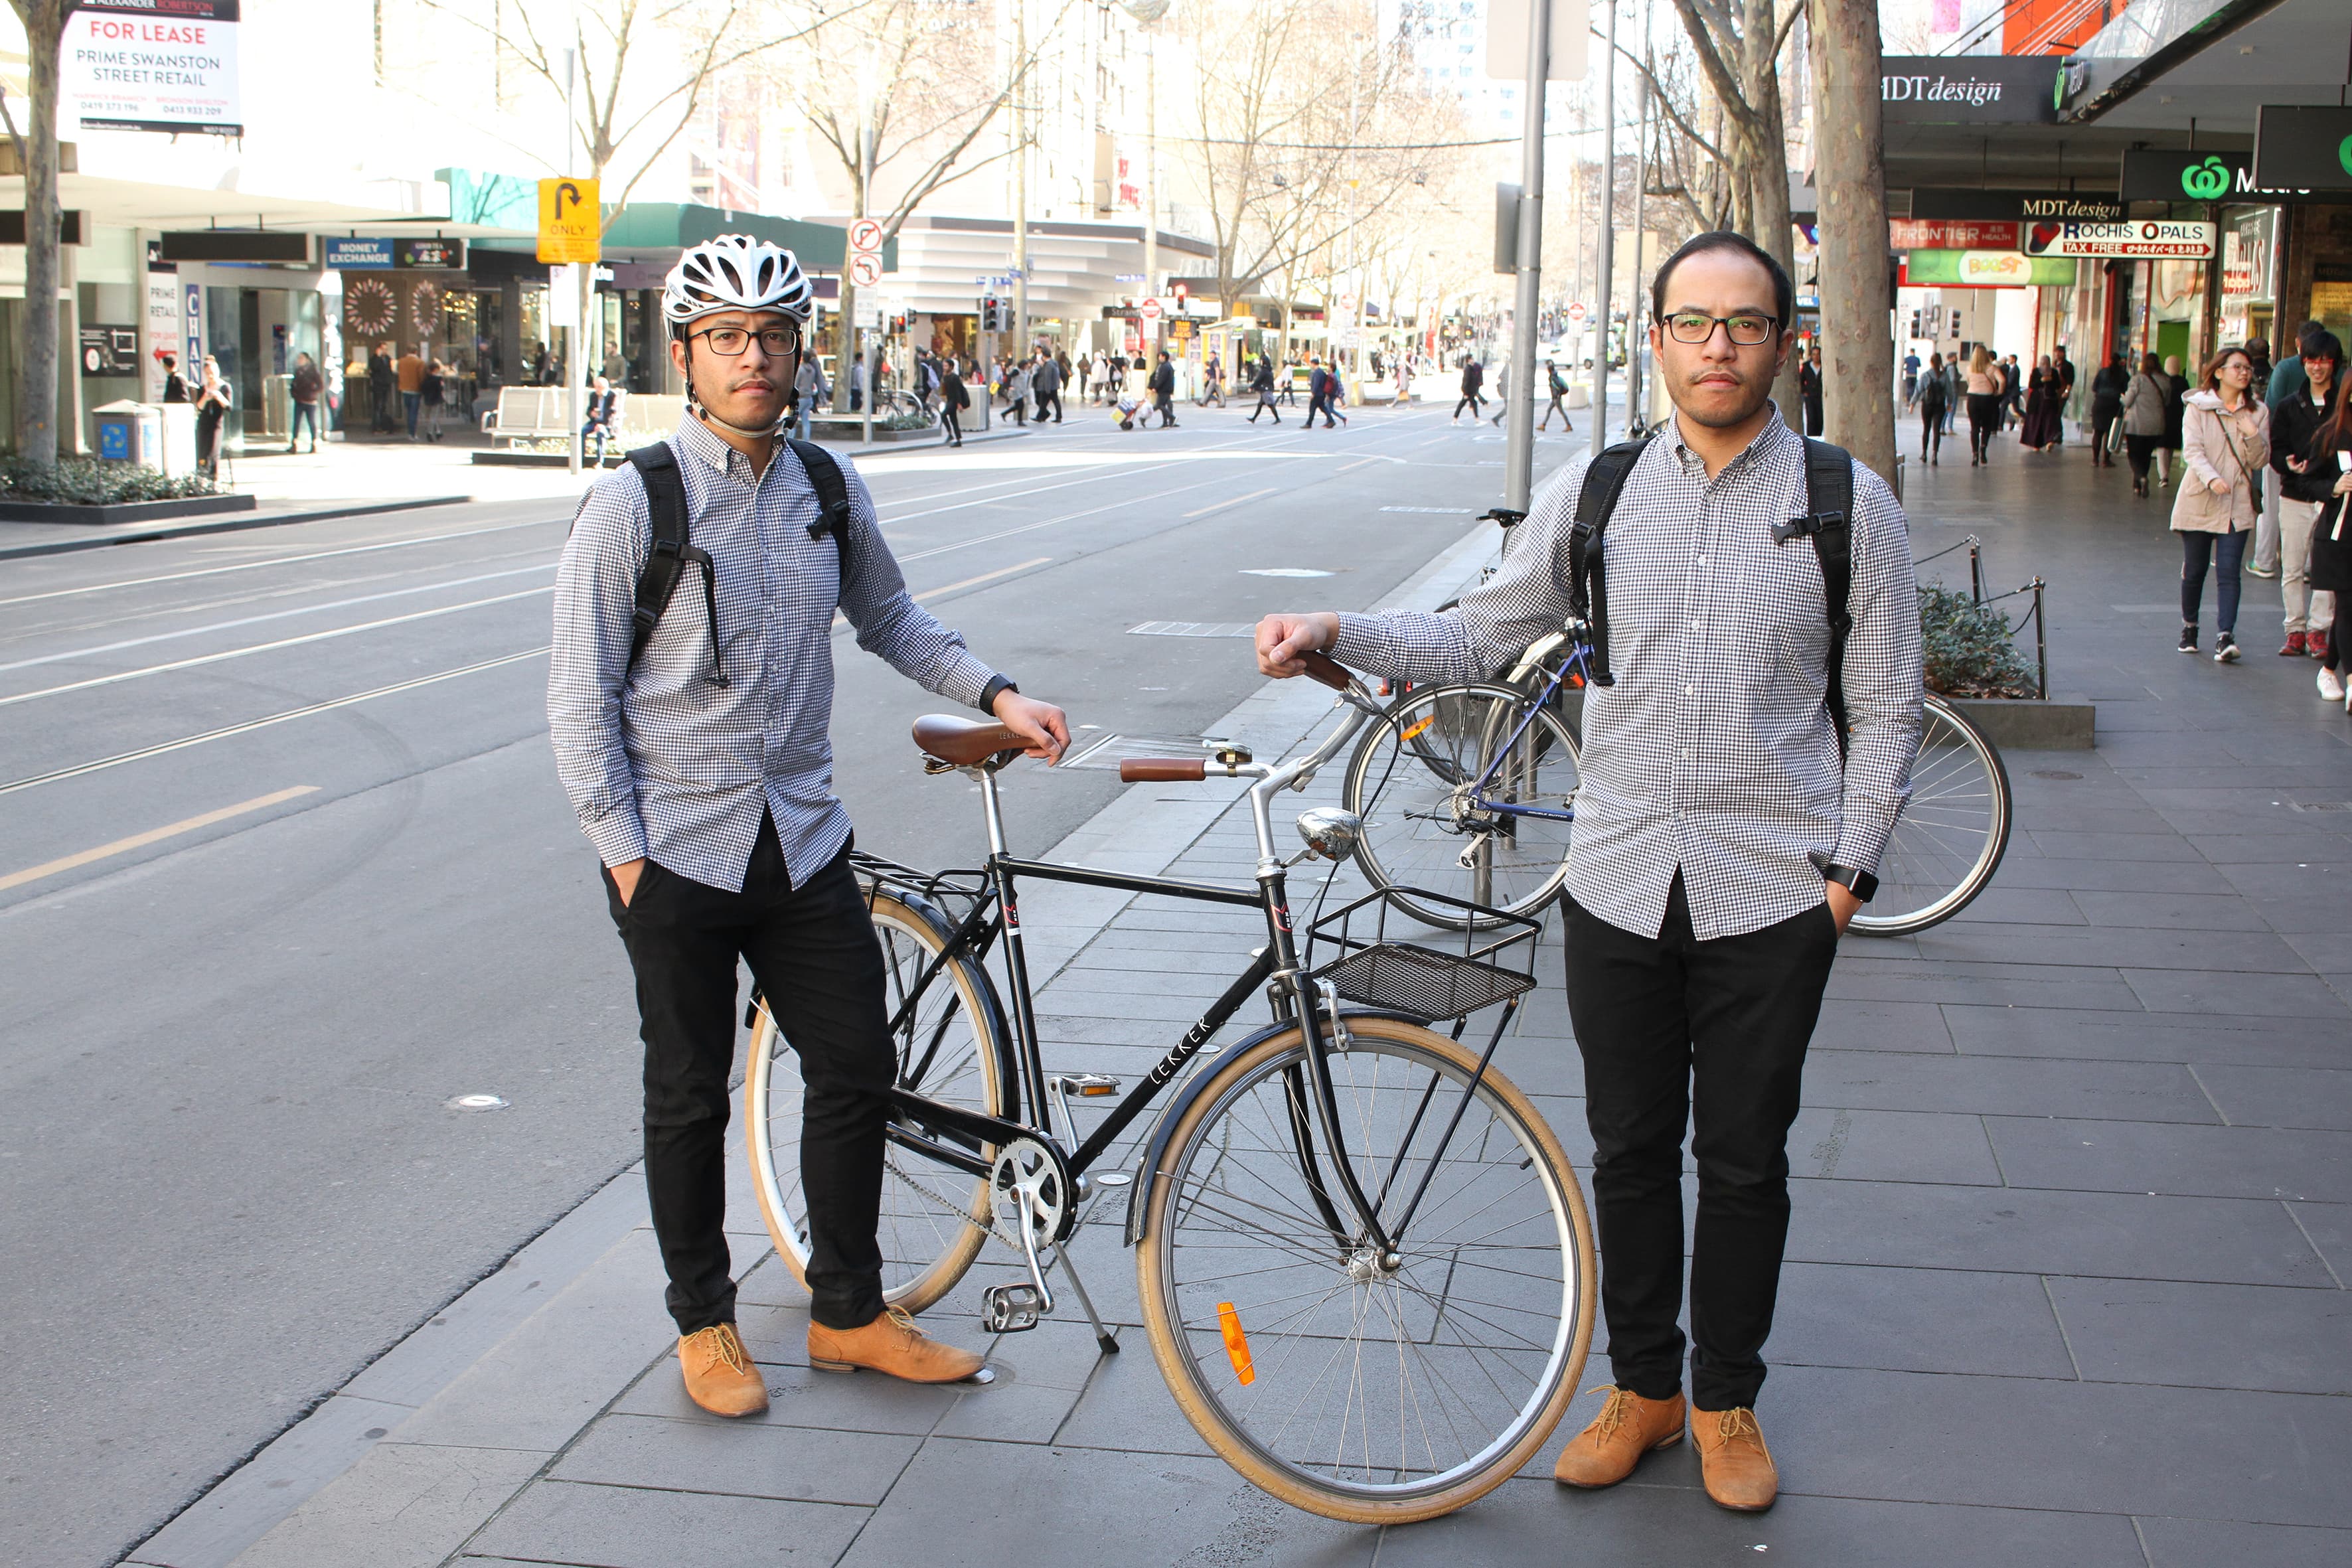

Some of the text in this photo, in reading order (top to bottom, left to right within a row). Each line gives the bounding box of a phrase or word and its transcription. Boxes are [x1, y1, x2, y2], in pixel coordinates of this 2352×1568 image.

[90, 21, 206, 44] FOR LEASE
[77, 49, 220, 70] PRIME SWANSTON
[94, 67, 206, 86] STREET RETAIL
[2023, 200, 2121, 220] MDTdesign
[550, 225, 587, 235] ONLY
[1897, 228, 1979, 241] FRONTIER
[2063, 222, 2203, 240] ROCHIS OPALS
[339, 243, 379, 253] MONEY
[2065, 242, 2123, 254] TAX FREE
[329, 253, 390, 263] EXCHANGE
[1969, 256, 2023, 274] BOOST
[151, 287, 176, 299] PRIME
[150, 307, 177, 318] RETAIL
[1150, 1016, 1210, 1085] LEKKER
